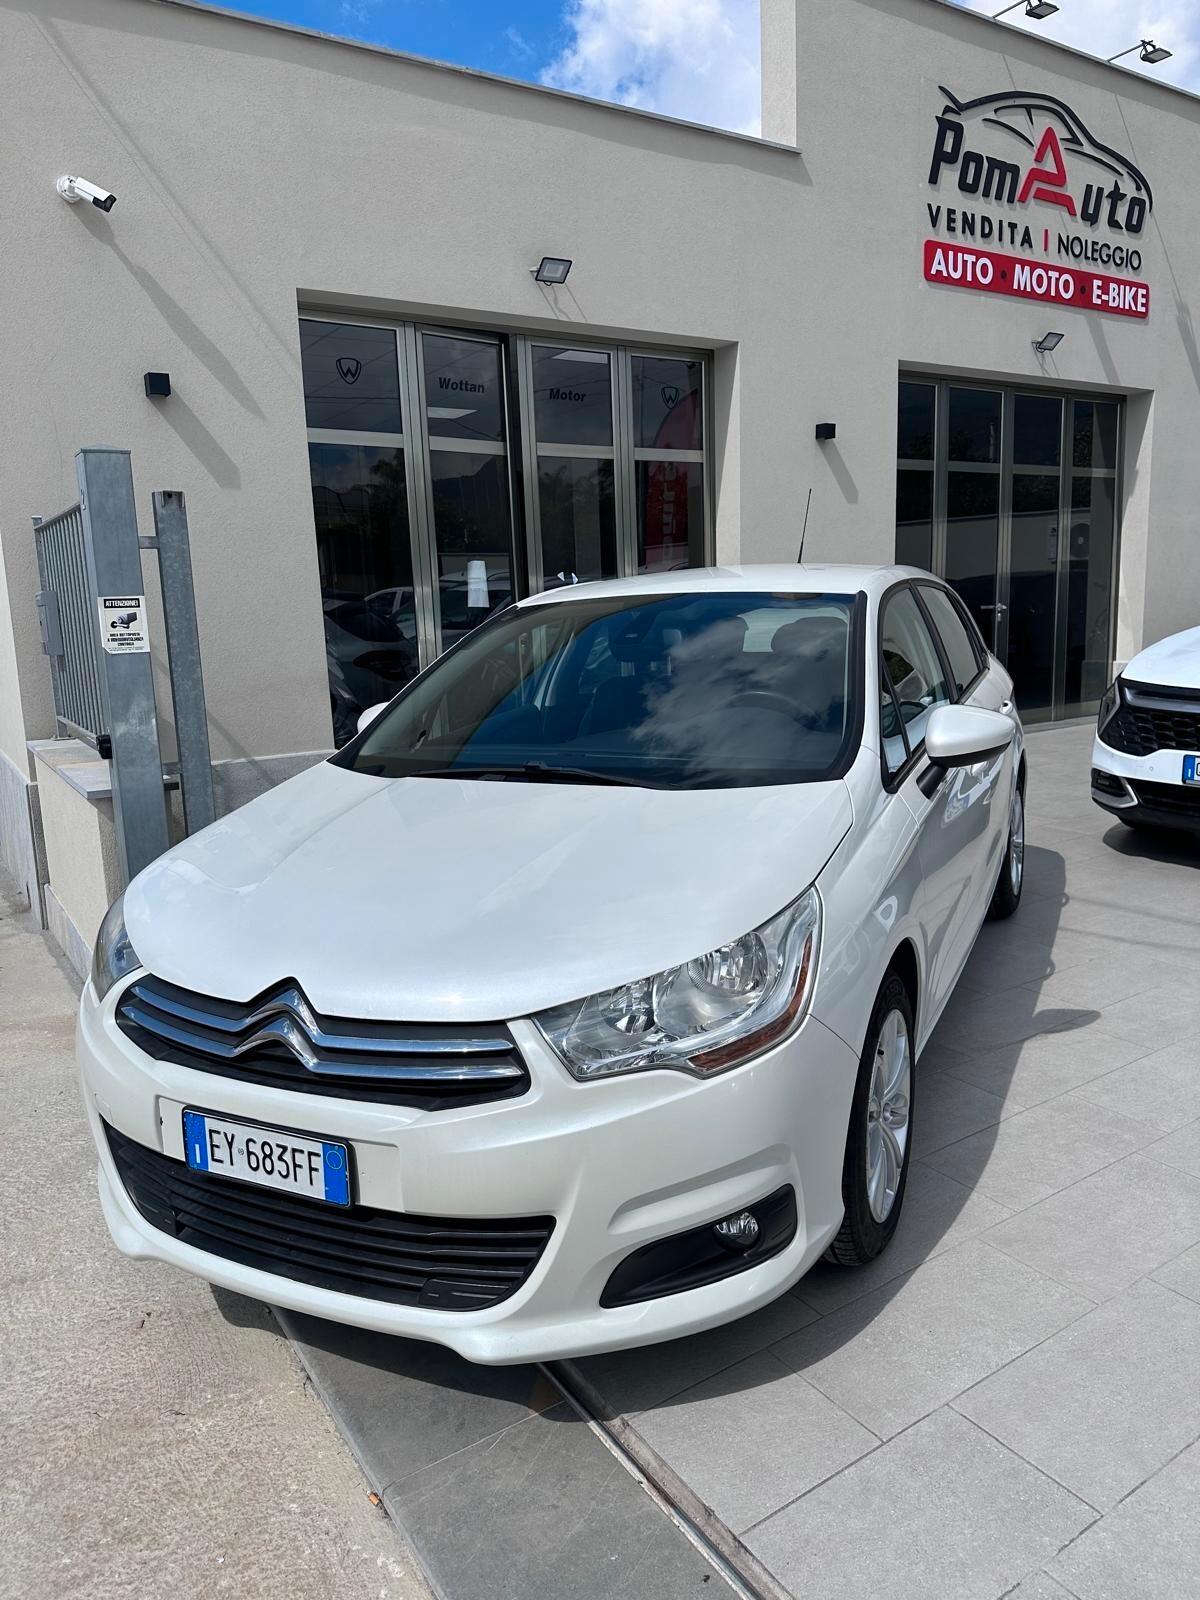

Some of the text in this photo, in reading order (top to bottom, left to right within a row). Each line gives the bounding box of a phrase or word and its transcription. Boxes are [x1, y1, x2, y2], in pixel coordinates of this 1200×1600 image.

[927, 203, 1142, 271] VENDITA NOLEGGIO
[930, 248, 1147, 313] AUTO MOTO E-BIKE
[438, 376, 587, 402] Wottan Motor
[208, 1128, 235, 1167] EY
[245, 1136, 322, 1187] 683FF
